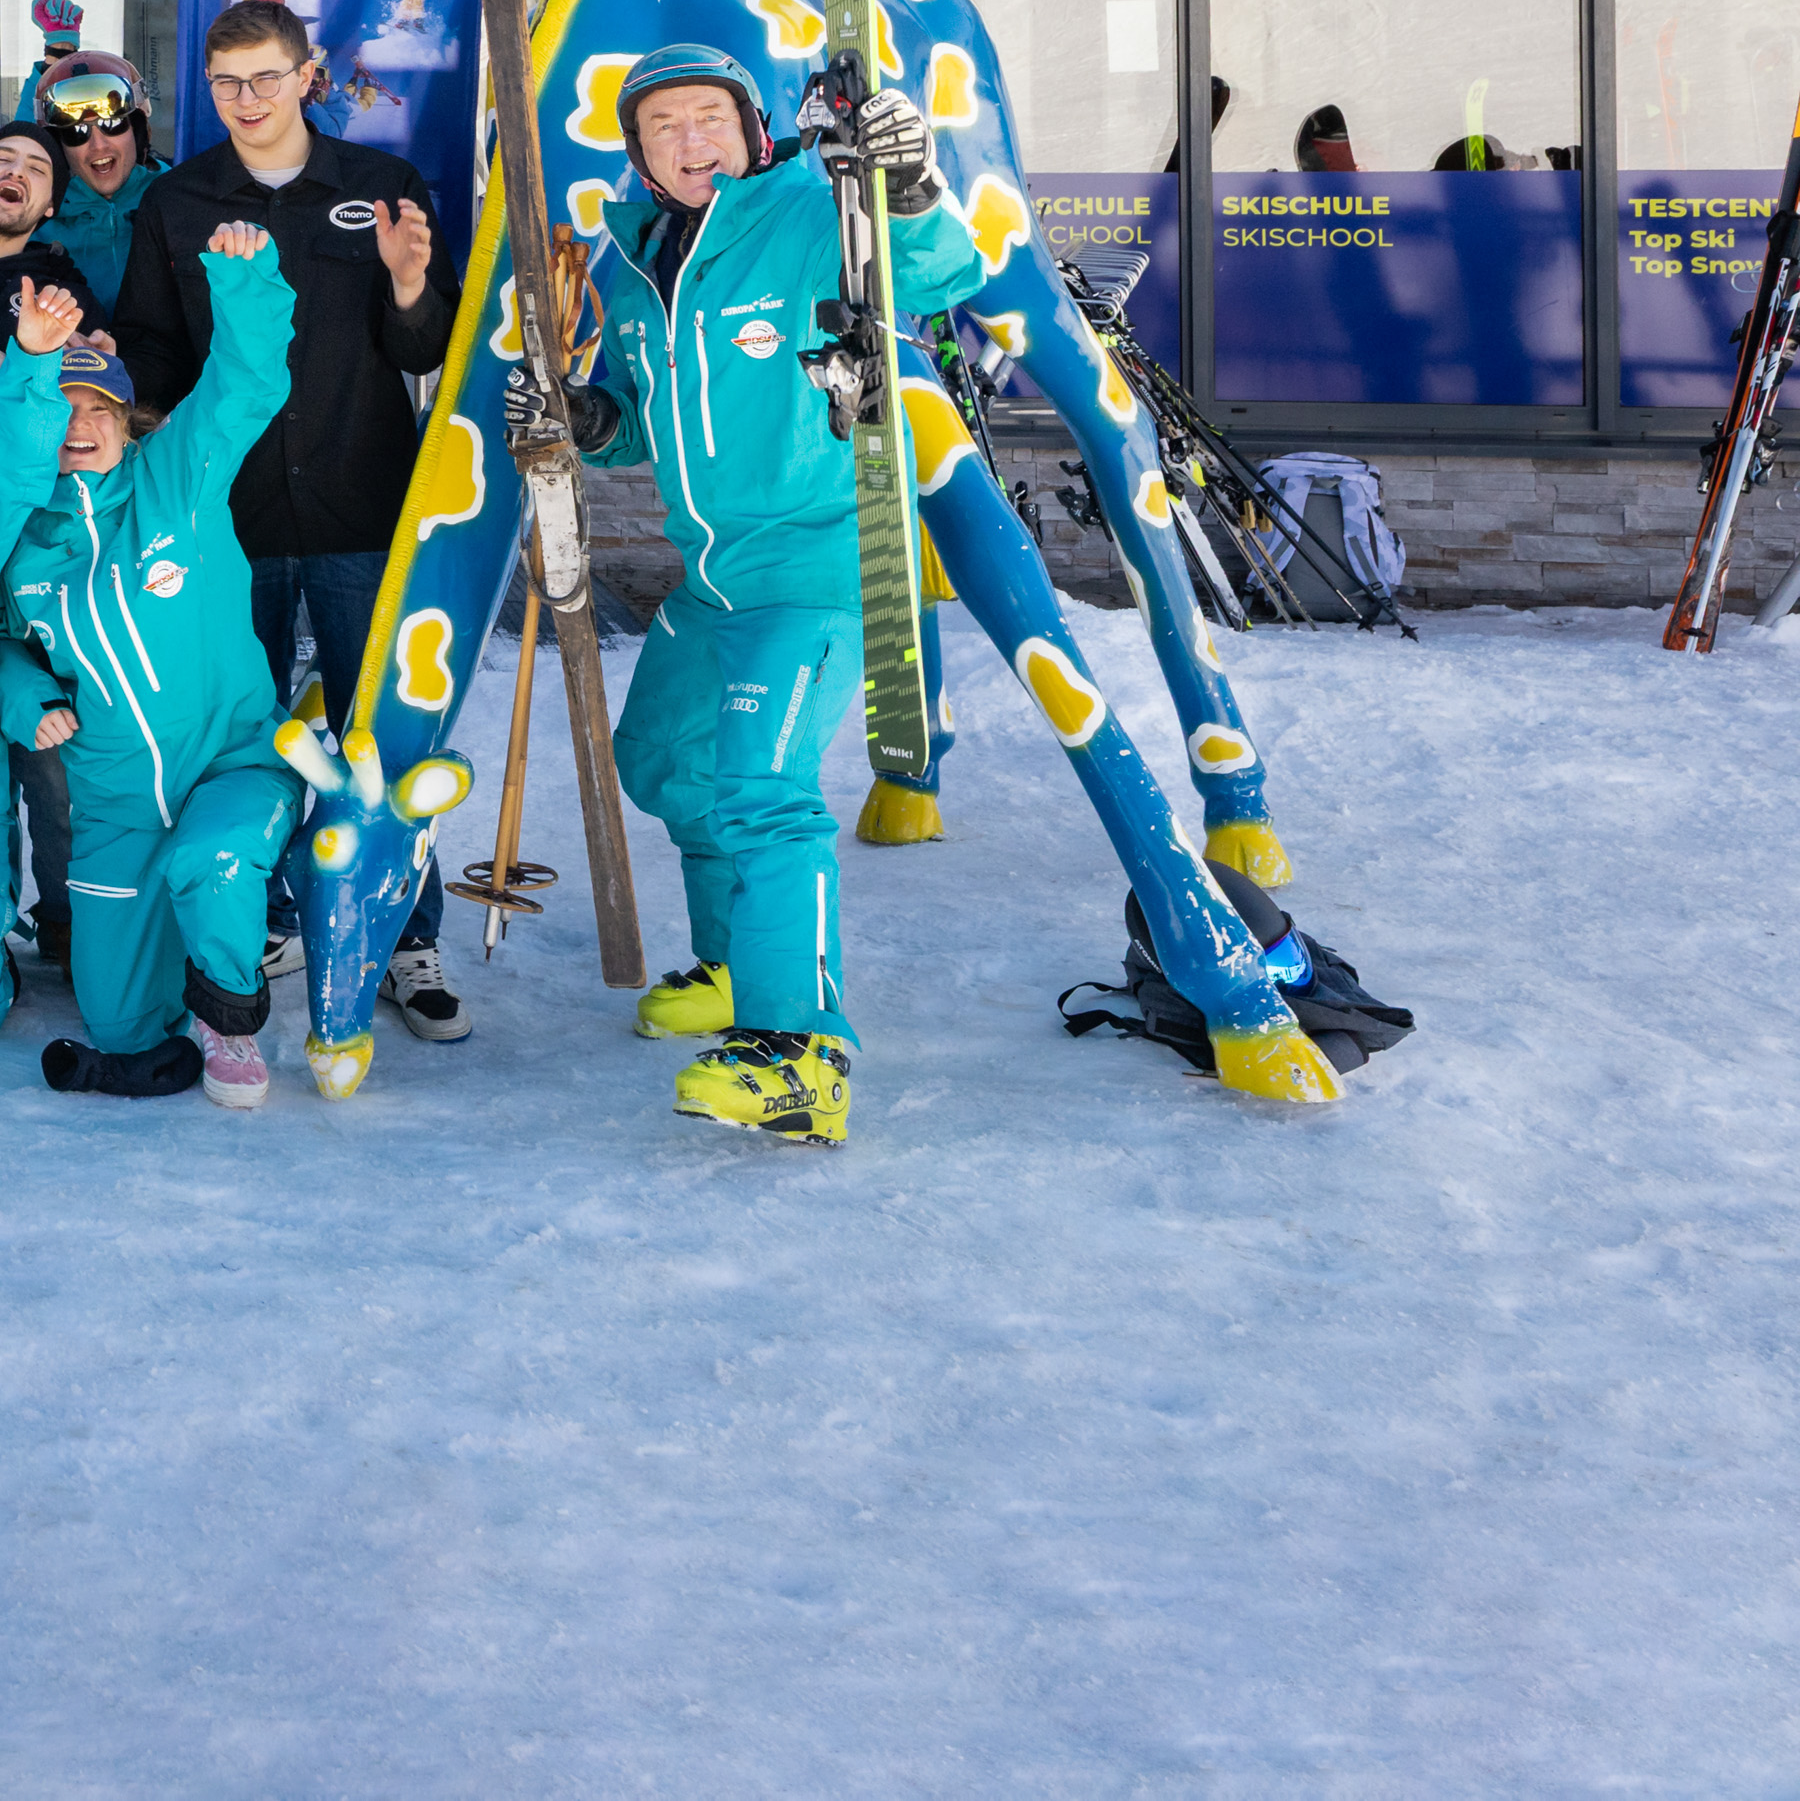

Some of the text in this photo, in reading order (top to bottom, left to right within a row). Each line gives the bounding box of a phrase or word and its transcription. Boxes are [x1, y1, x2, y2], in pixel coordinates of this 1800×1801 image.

[149, 36, 161, 102] Reichmann
[338, 211, 372, 219] Thoma
[1030, 197, 1150, 216] SCHULE
[1222, 196, 1390, 216] SKISCHULE
[1046, 226, 1152, 245] CHOOL
[1223, 227, 1393, 248] SKISCHOOL
[1629, 228, 1735, 252] Top Ski
[1629, 256, 1683, 278] Top
[721, 299, 785, 317] EUROPA PARK
[64, 355, 99, 365] Thoma
[155, 534, 175, 551] PARK
[779, 665, 811, 740] EXPERIENCE
[880, 745, 913, 759] Völkl
[1134, 939, 1162, 974] ATOMIC
[763, 1088, 818, 1114] DALBELLO
